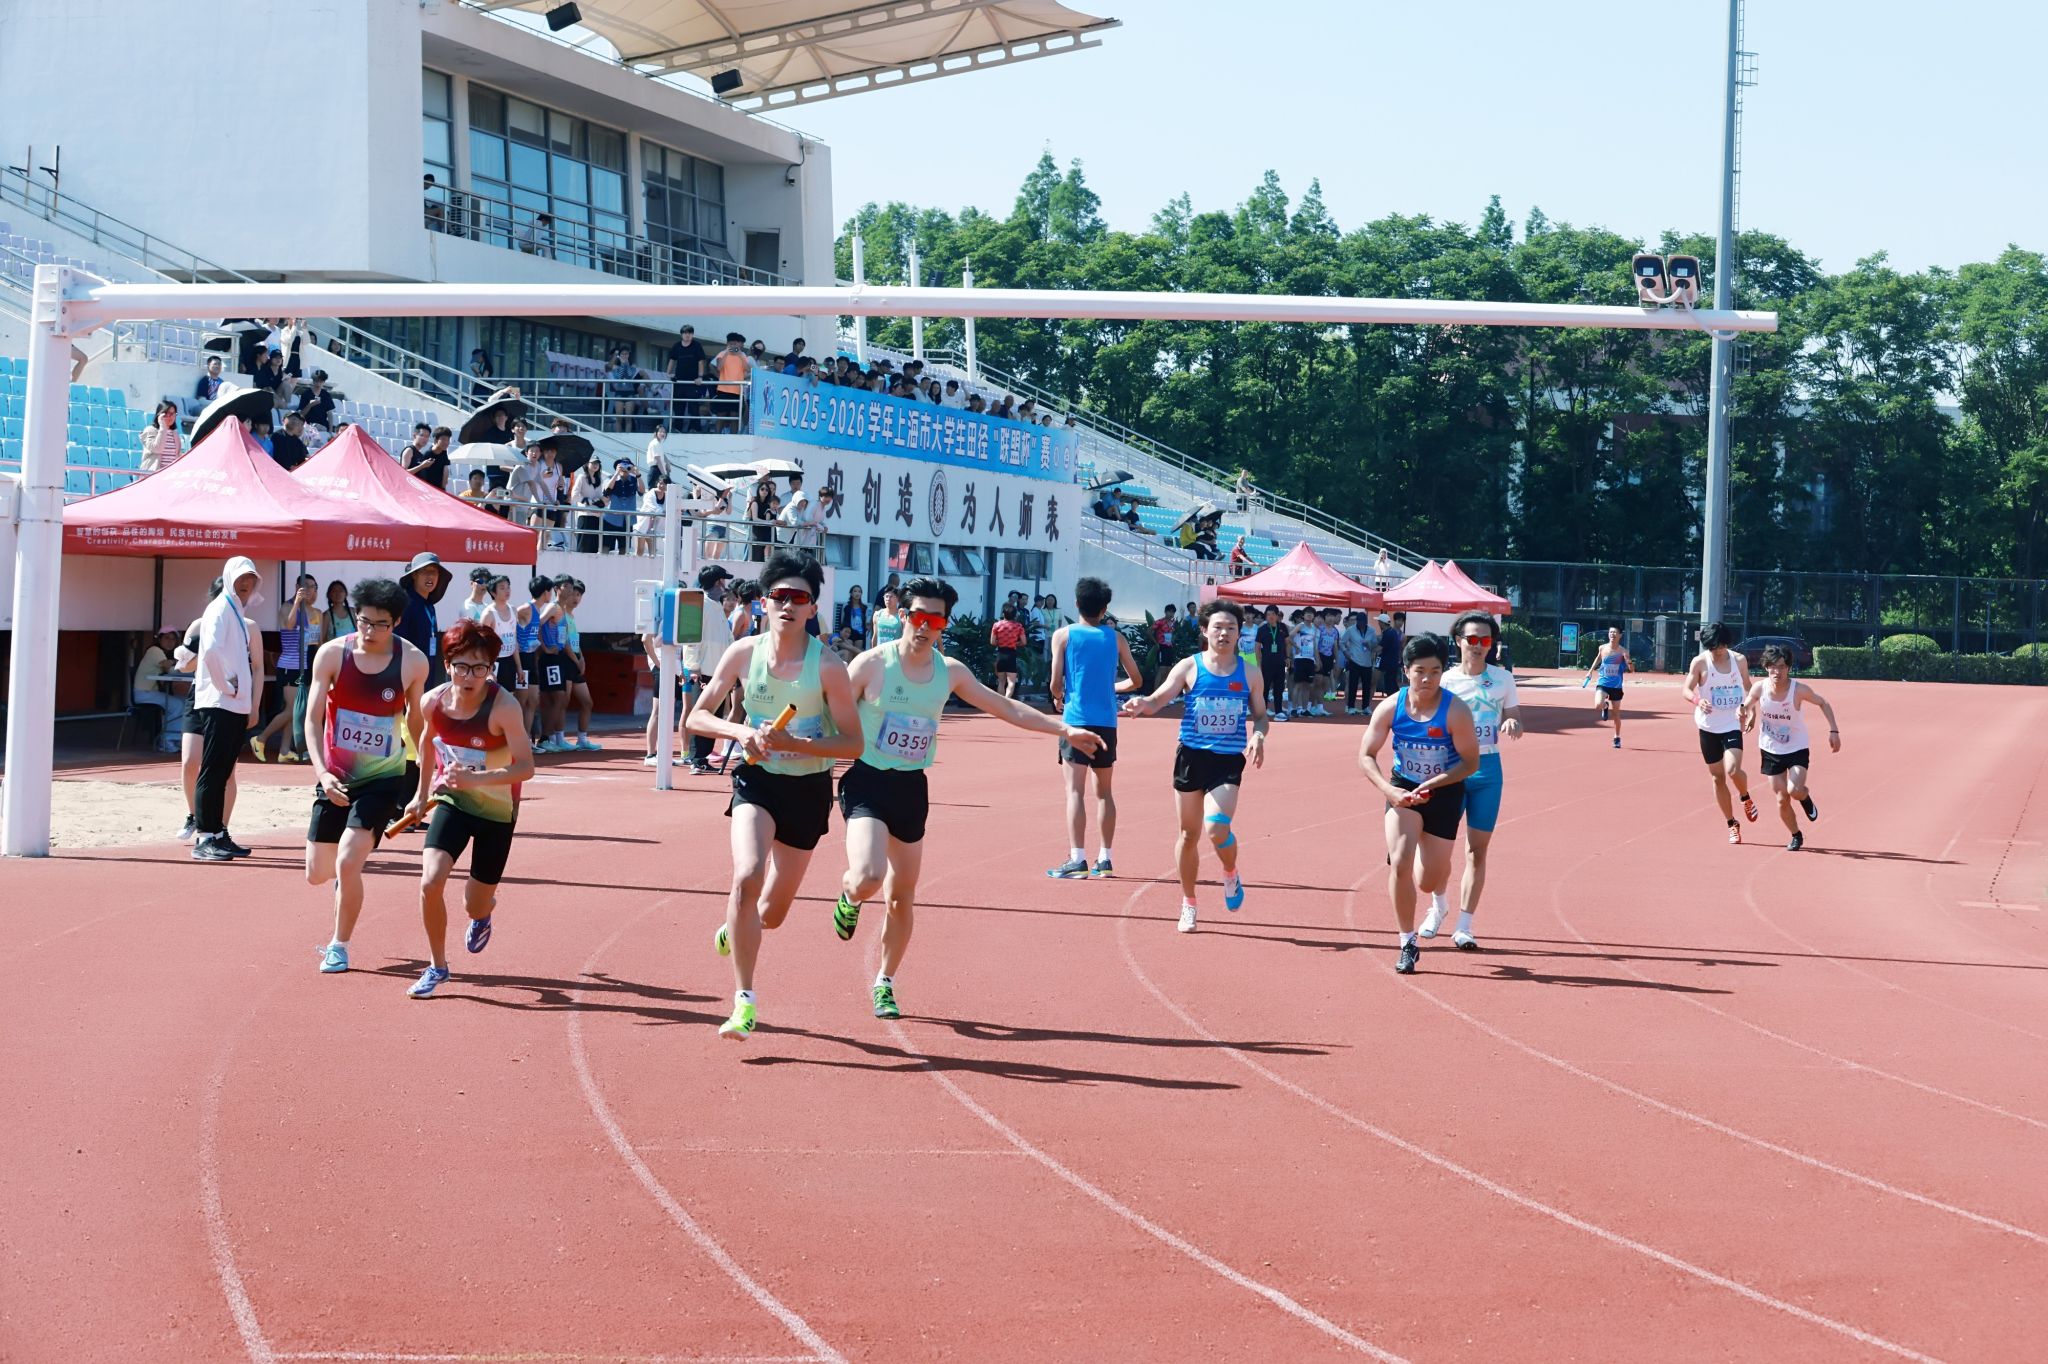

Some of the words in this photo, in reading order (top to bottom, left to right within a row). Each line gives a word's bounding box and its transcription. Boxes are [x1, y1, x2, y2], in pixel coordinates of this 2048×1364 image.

[795, 458, 914, 527] 实创造
[961, 482, 1060, 543] 为人师表
[549, 667, 559, 683] 5
[1716, 696, 1739, 706] 0152
[1201, 714, 1236, 727] 0235
[342, 727, 384, 747] 0429
[1475, 725, 1491, 737] 93
[887, 731, 928, 750] 0359
[1406, 759, 1441, 775] 0236
